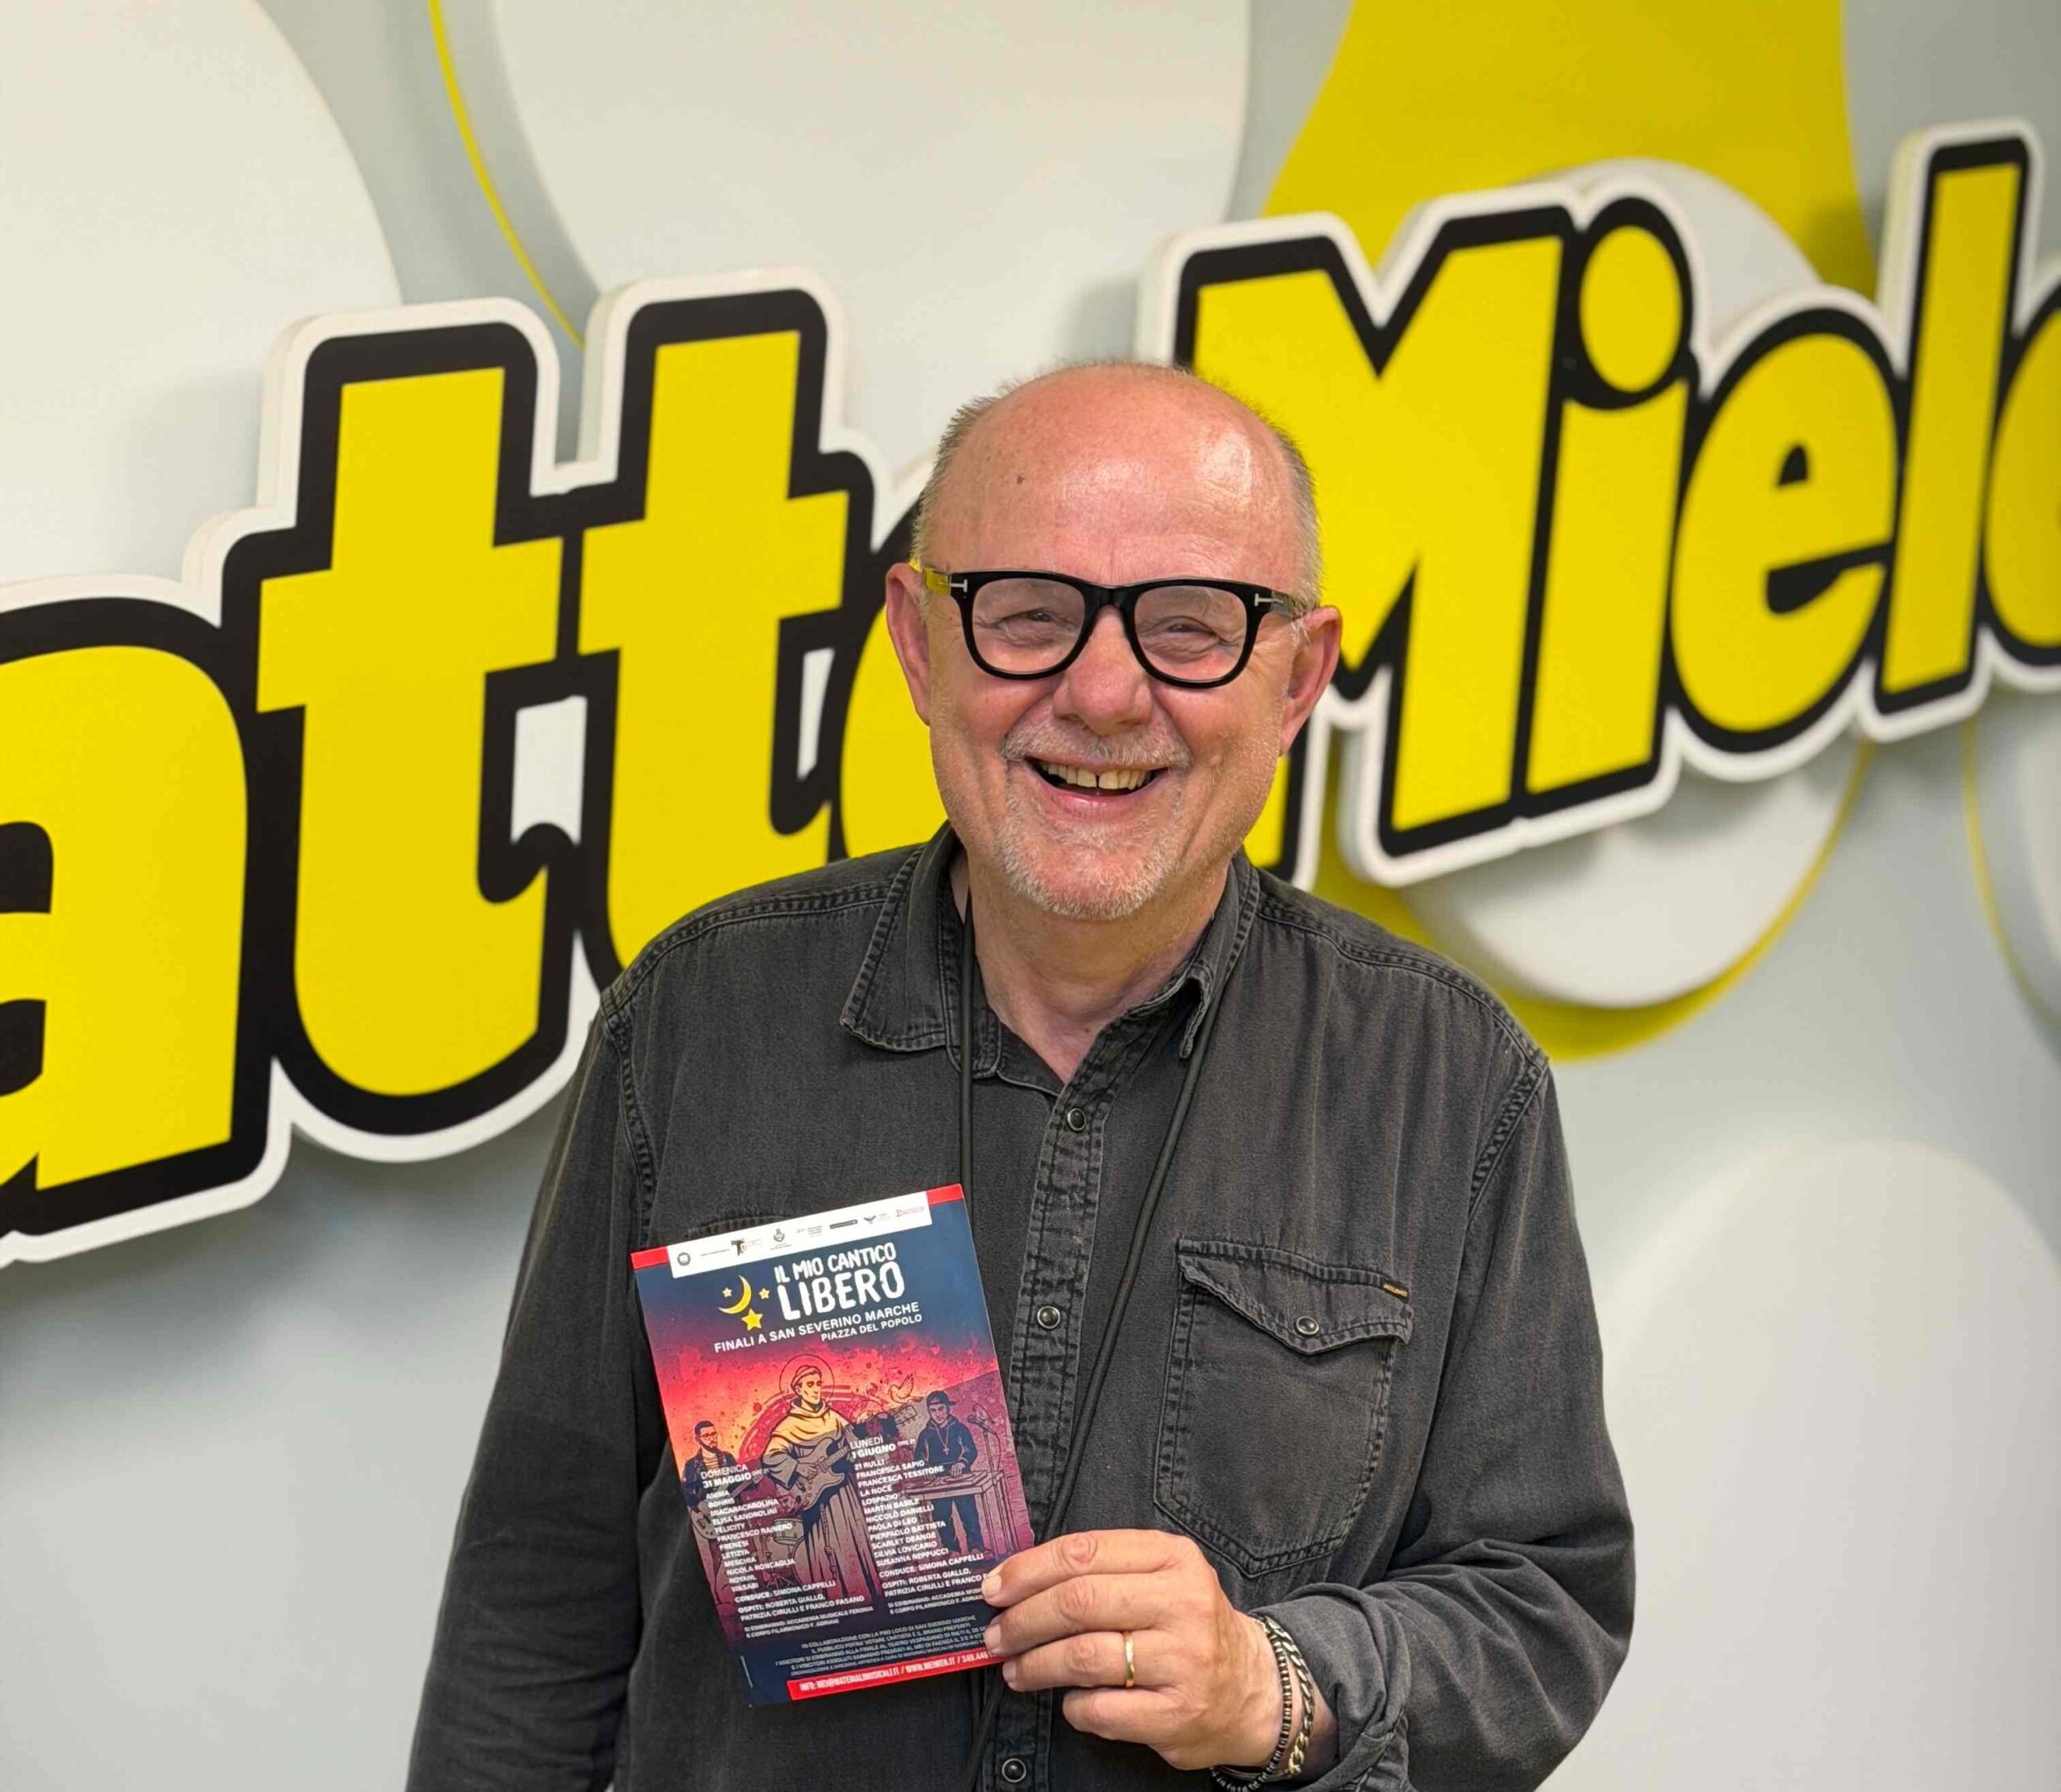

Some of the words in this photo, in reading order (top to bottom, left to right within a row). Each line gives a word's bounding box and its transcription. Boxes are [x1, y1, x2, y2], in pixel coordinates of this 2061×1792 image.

[774, 1264, 791, 1283] IL
[791, 1258, 824, 1280] MIO
[825, 1241, 897, 1273] CANTICO
[775, 1260, 907, 1321] LIBERO
[713, 1336, 754, 1352] FINALI
[757, 1333, 766, 1344] A
[768, 1327, 795, 1341] SAN
[797, 1314, 862, 1336] SEVERINO
[865, 1302, 919, 1321] MARCHE
[820, 1327, 857, 1341] PIAZZA
[859, 1323, 878, 1333] DEL
[881, 1314, 923, 1329] POPOLO
[857, 1443, 896, 1457] GIUGNO
[700, 1463, 748, 1480] DOMENICA
[702, 1480, 712, 1489] 31
[713, 1472, 752, 1486] MAGGIO
[951, 1574, 981, 1586] FRANCO
